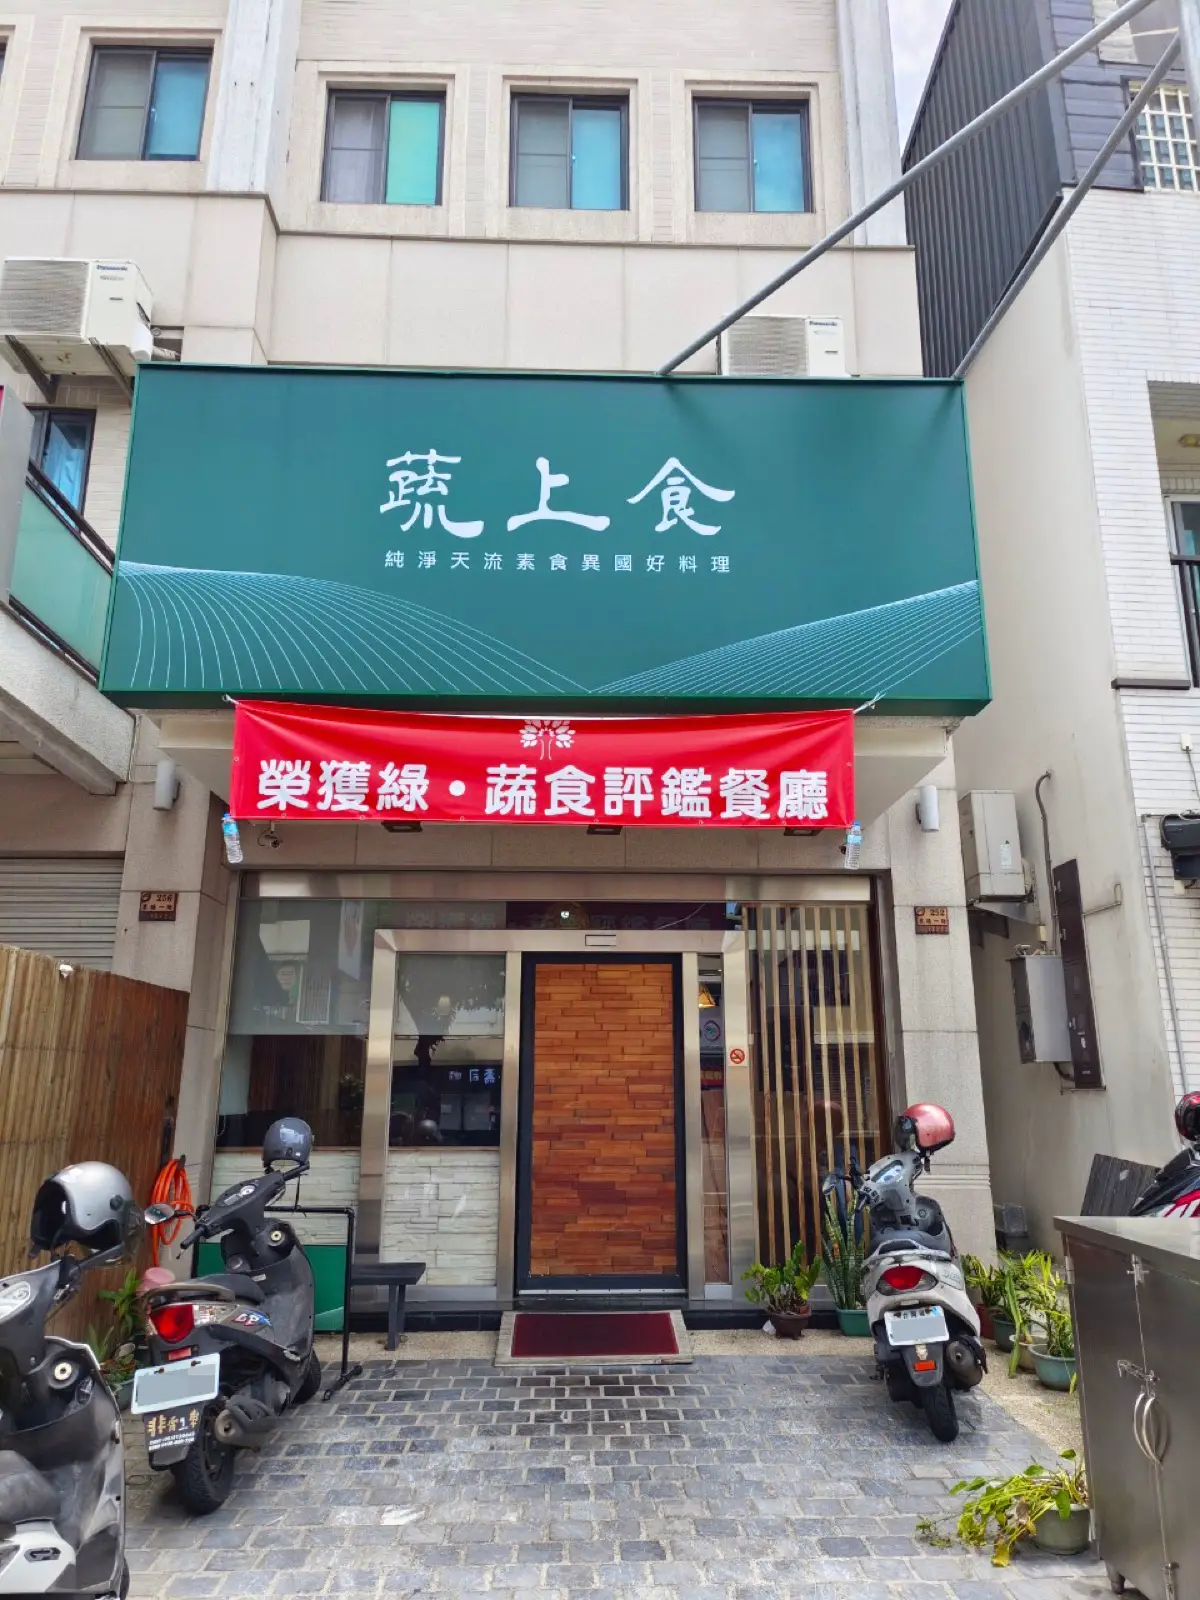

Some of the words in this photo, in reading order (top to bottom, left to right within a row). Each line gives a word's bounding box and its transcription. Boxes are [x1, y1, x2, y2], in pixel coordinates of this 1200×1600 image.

[379, 448, 736, 538] 蔬上食
[384, 549, 731, 574] 純淨天流素食異國好料理
